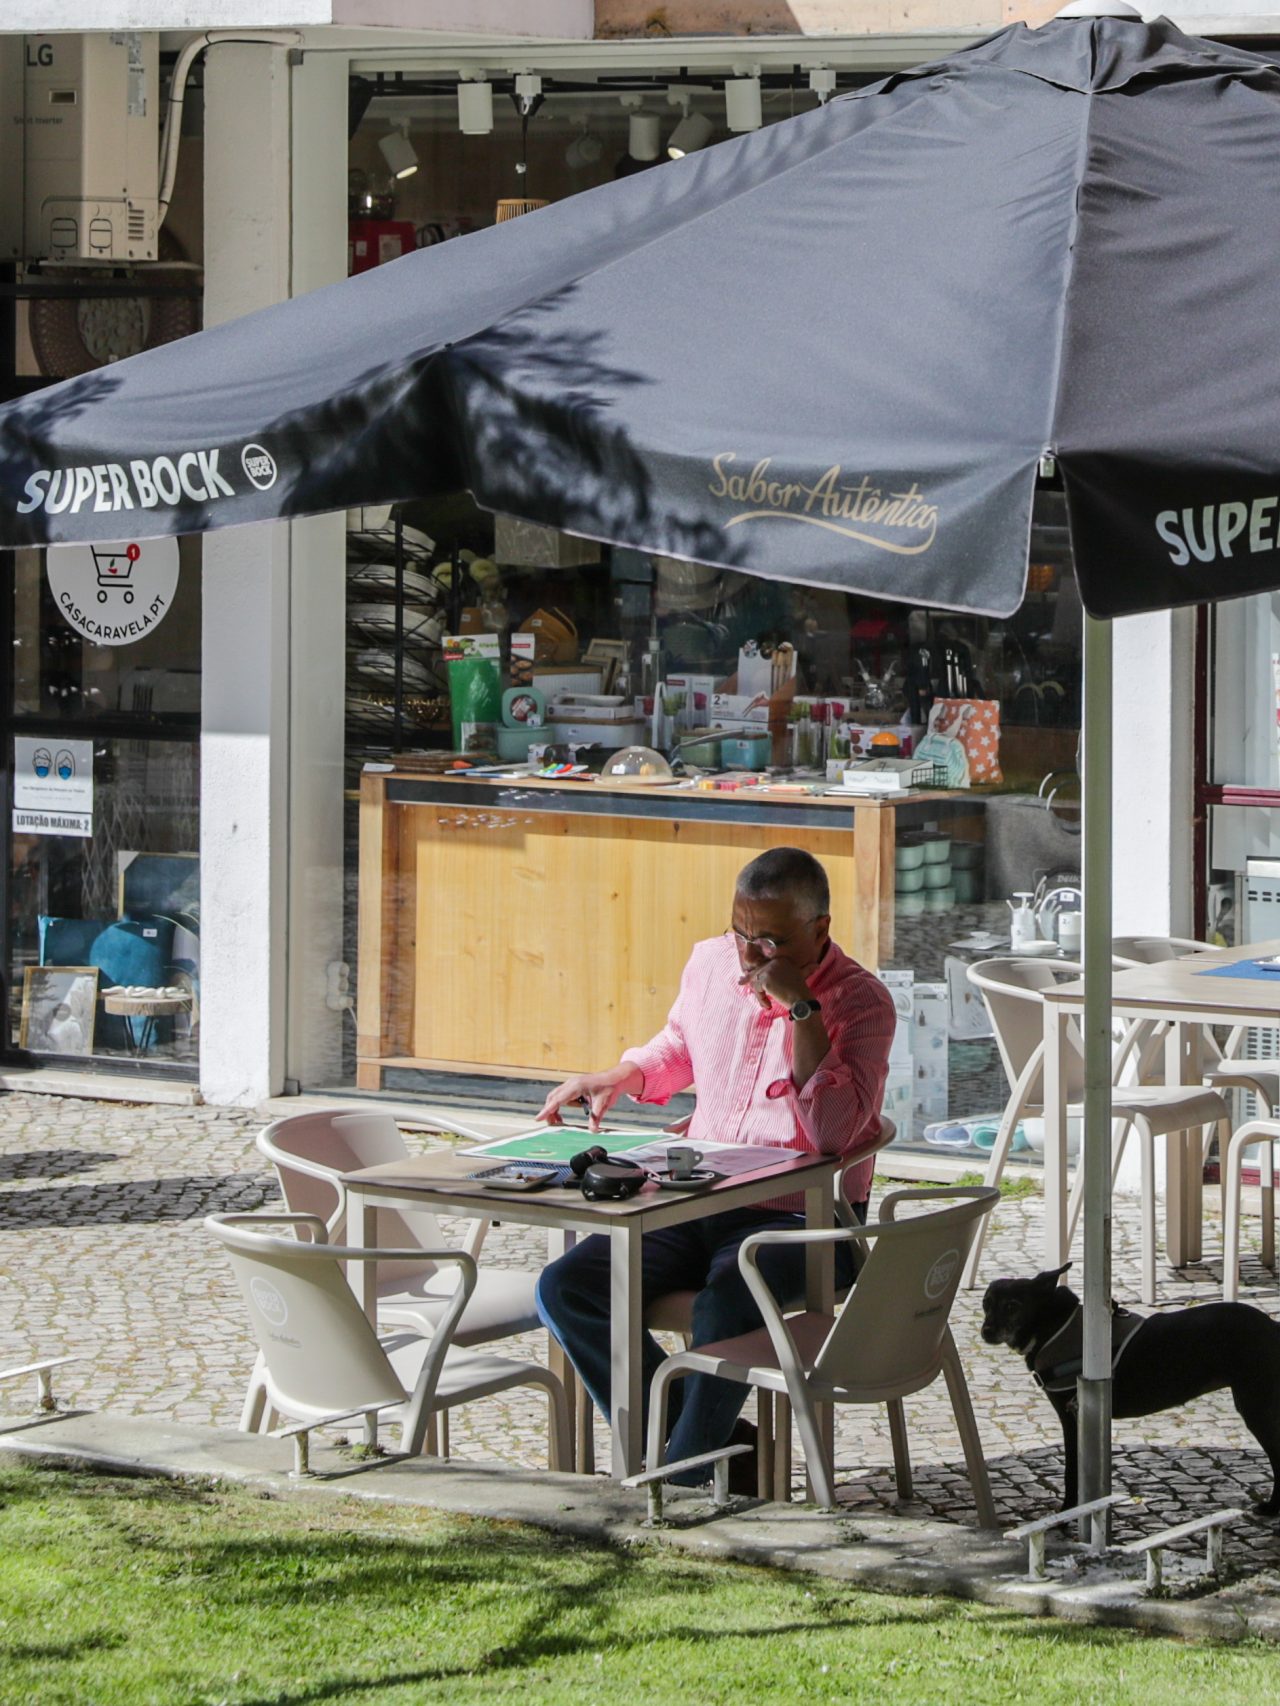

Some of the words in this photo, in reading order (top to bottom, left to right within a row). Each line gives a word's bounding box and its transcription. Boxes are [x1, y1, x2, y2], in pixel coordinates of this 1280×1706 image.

[26, 43, 54, 67] LG
[245, 455, 271, 468] SUPER
[250, 464, 273, 478] BOCK
[16, 463, 134, 514] SUPER
[130, 448, 236, 509] BOCK
[708, 451, 801, 507] Sabor
[799, 463, 939, 533] Autêntico
[60, 591, 166, 640] CASACARAVELA.PT
[16, 814, 50, 829] LOTAÇÃO
[50, 816, 83, 830] MÁXIMA:
[83, 819, 90, 831] 2
